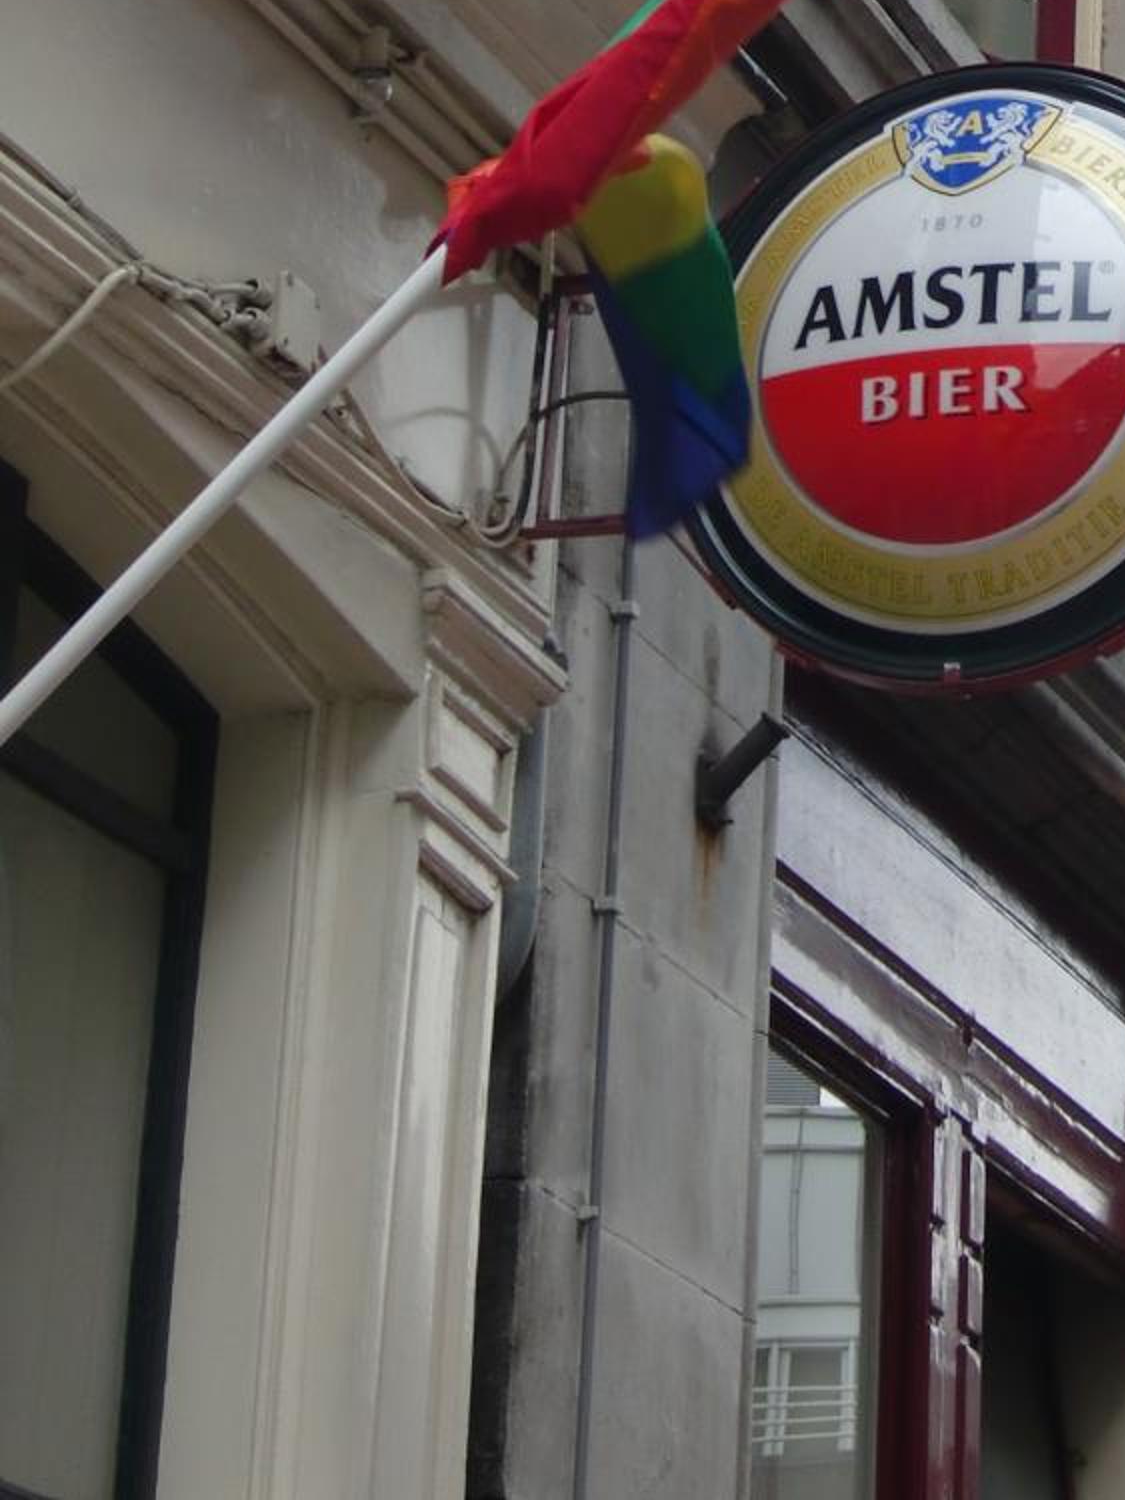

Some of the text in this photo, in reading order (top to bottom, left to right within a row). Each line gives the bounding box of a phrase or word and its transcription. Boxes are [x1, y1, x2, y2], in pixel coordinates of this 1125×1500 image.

[921, 213, 985, 233] 1870
[794, 258, 1114, 350] AMSTEL
[861, 365, 1028, 425] BIER
